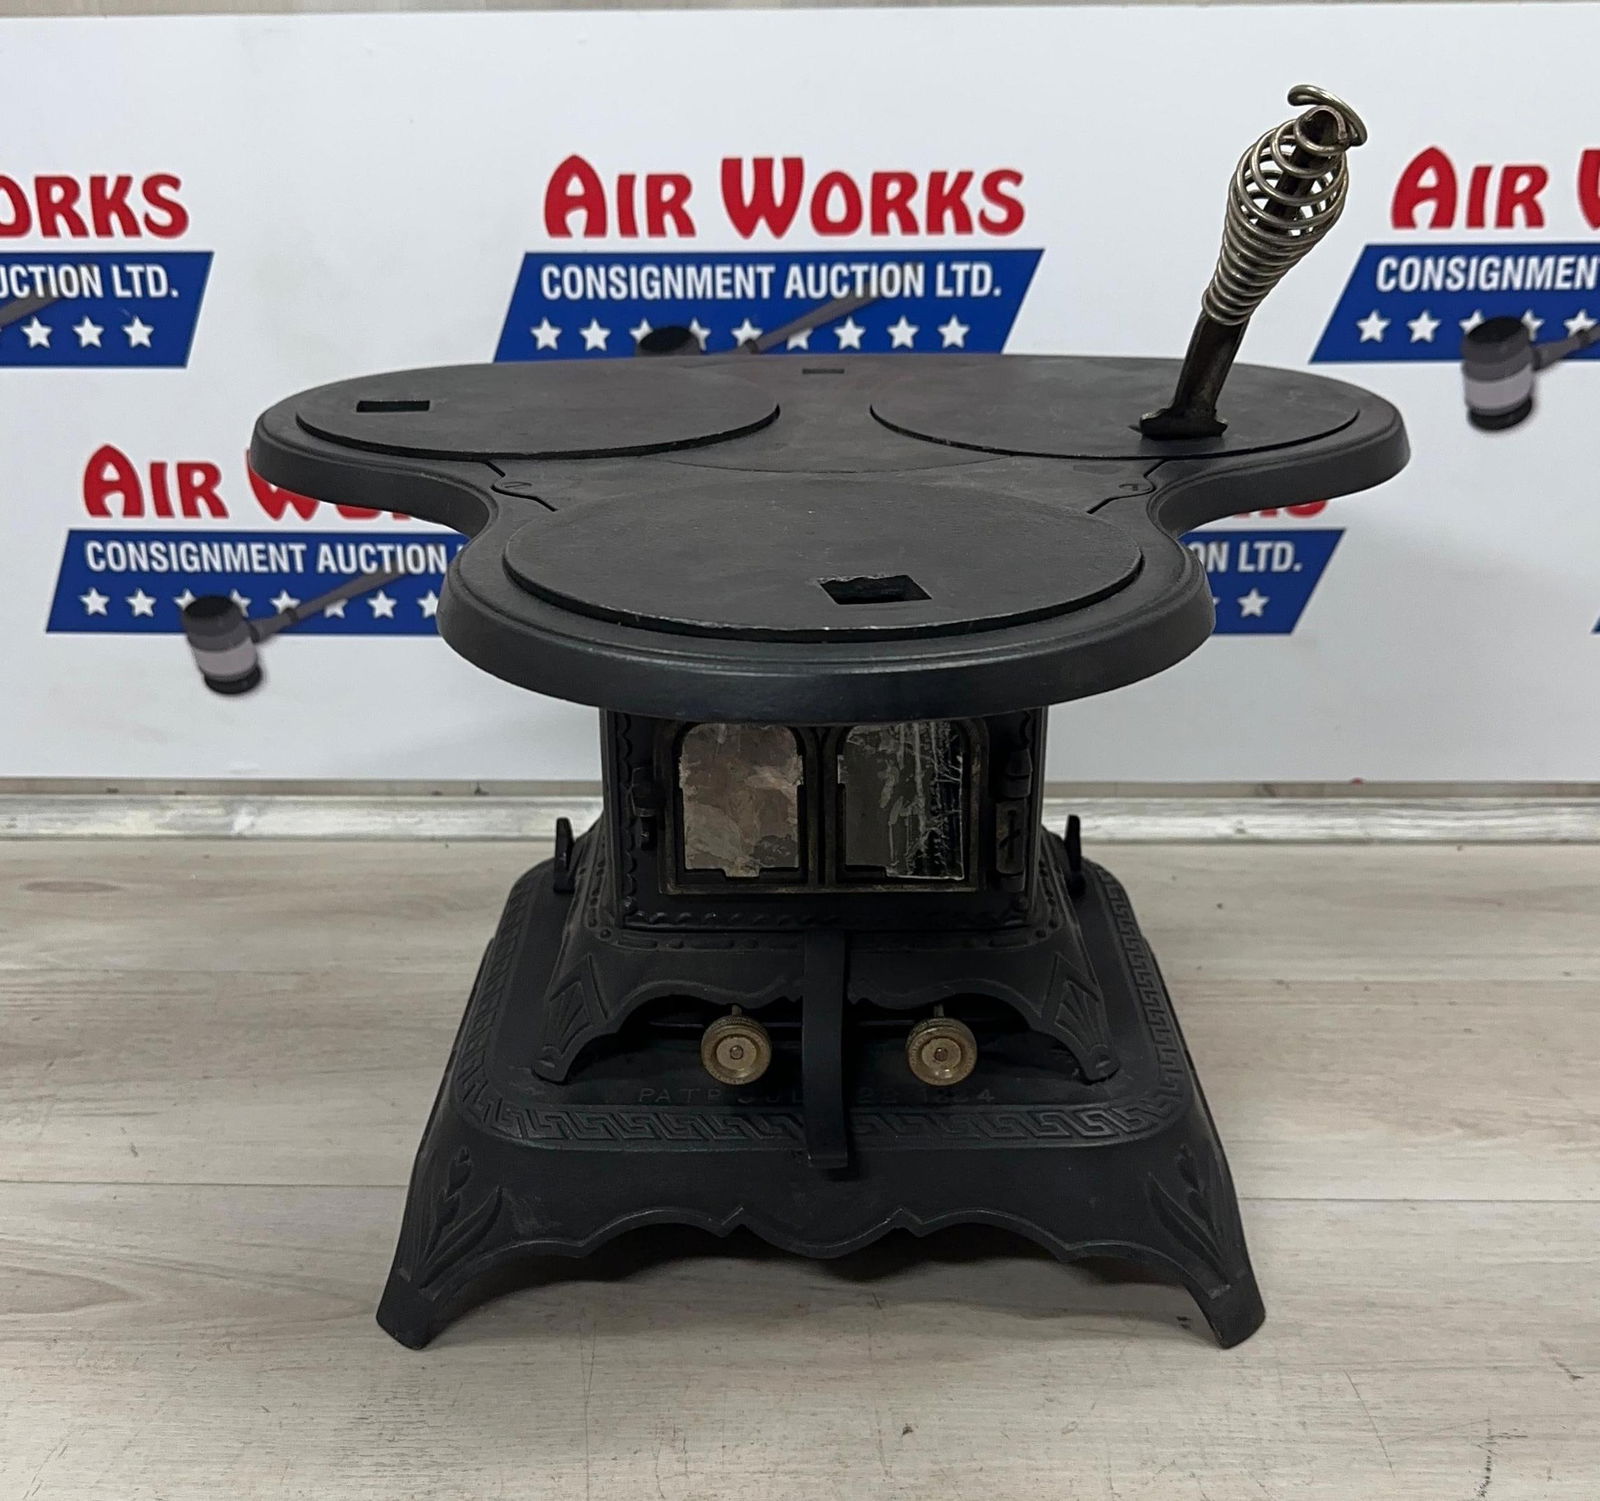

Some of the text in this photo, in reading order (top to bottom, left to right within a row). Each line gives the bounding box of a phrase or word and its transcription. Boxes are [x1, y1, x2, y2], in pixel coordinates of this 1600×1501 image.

[542, 154, 1026, 239] AIR WORKS
[1390, 146, 1550, 230] AIR
[111, 263, 180, 299] LTD.
[540, 262, 1002, 301] CONSIGNMENT AUCTION LTD.
[1375, 255, 1600, 292] CONSIGNMEN
[82, 444, 230, 520] AIR
[85, 540, 449, 575] CONSIGNMENT AUCTION
[1237, 540, 1303, 573] LTD.
